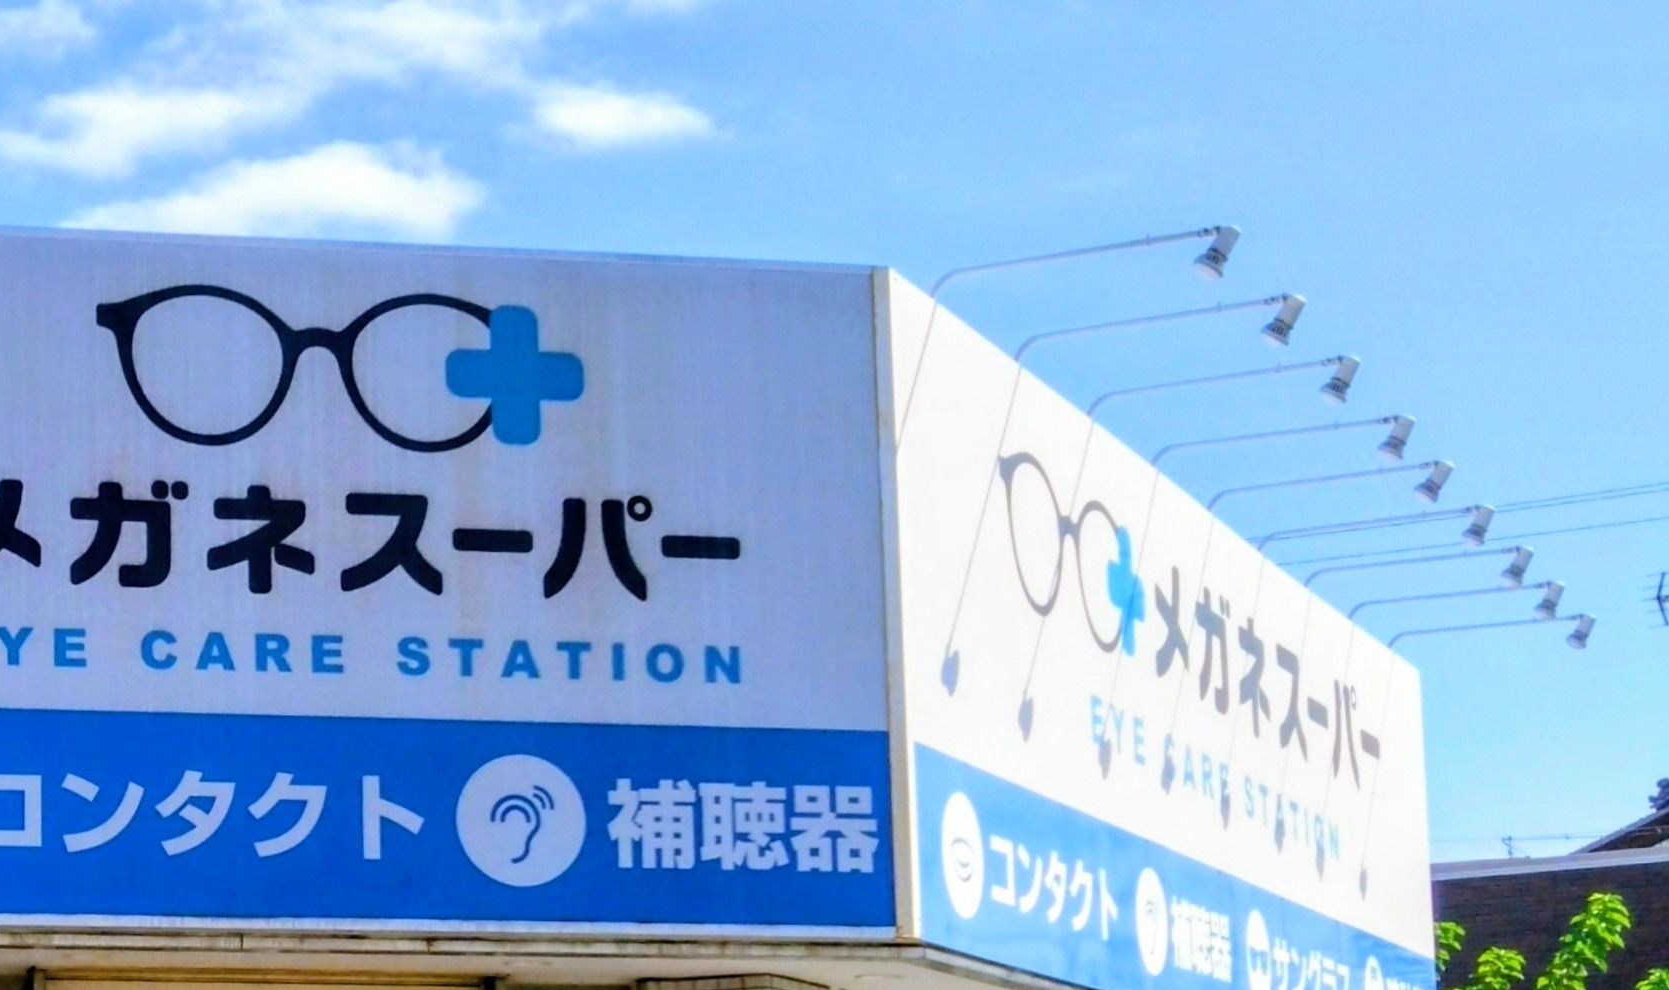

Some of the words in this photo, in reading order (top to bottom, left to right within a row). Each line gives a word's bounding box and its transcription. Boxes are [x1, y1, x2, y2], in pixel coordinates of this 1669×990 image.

[140, 627, 346, 675] CARE
[396, 635, 743, 685] STATION
[1153, 566, 1381, 789] メガネスーパー
[605, 775, 880, 875] 補聴器
[1089, 694, 1146, 767] EYE
[1162, 732, 1230, 799] CARE
[1243, 773, 1340, 860] STATION
[989, 832, 1119, 941] コンタクト
